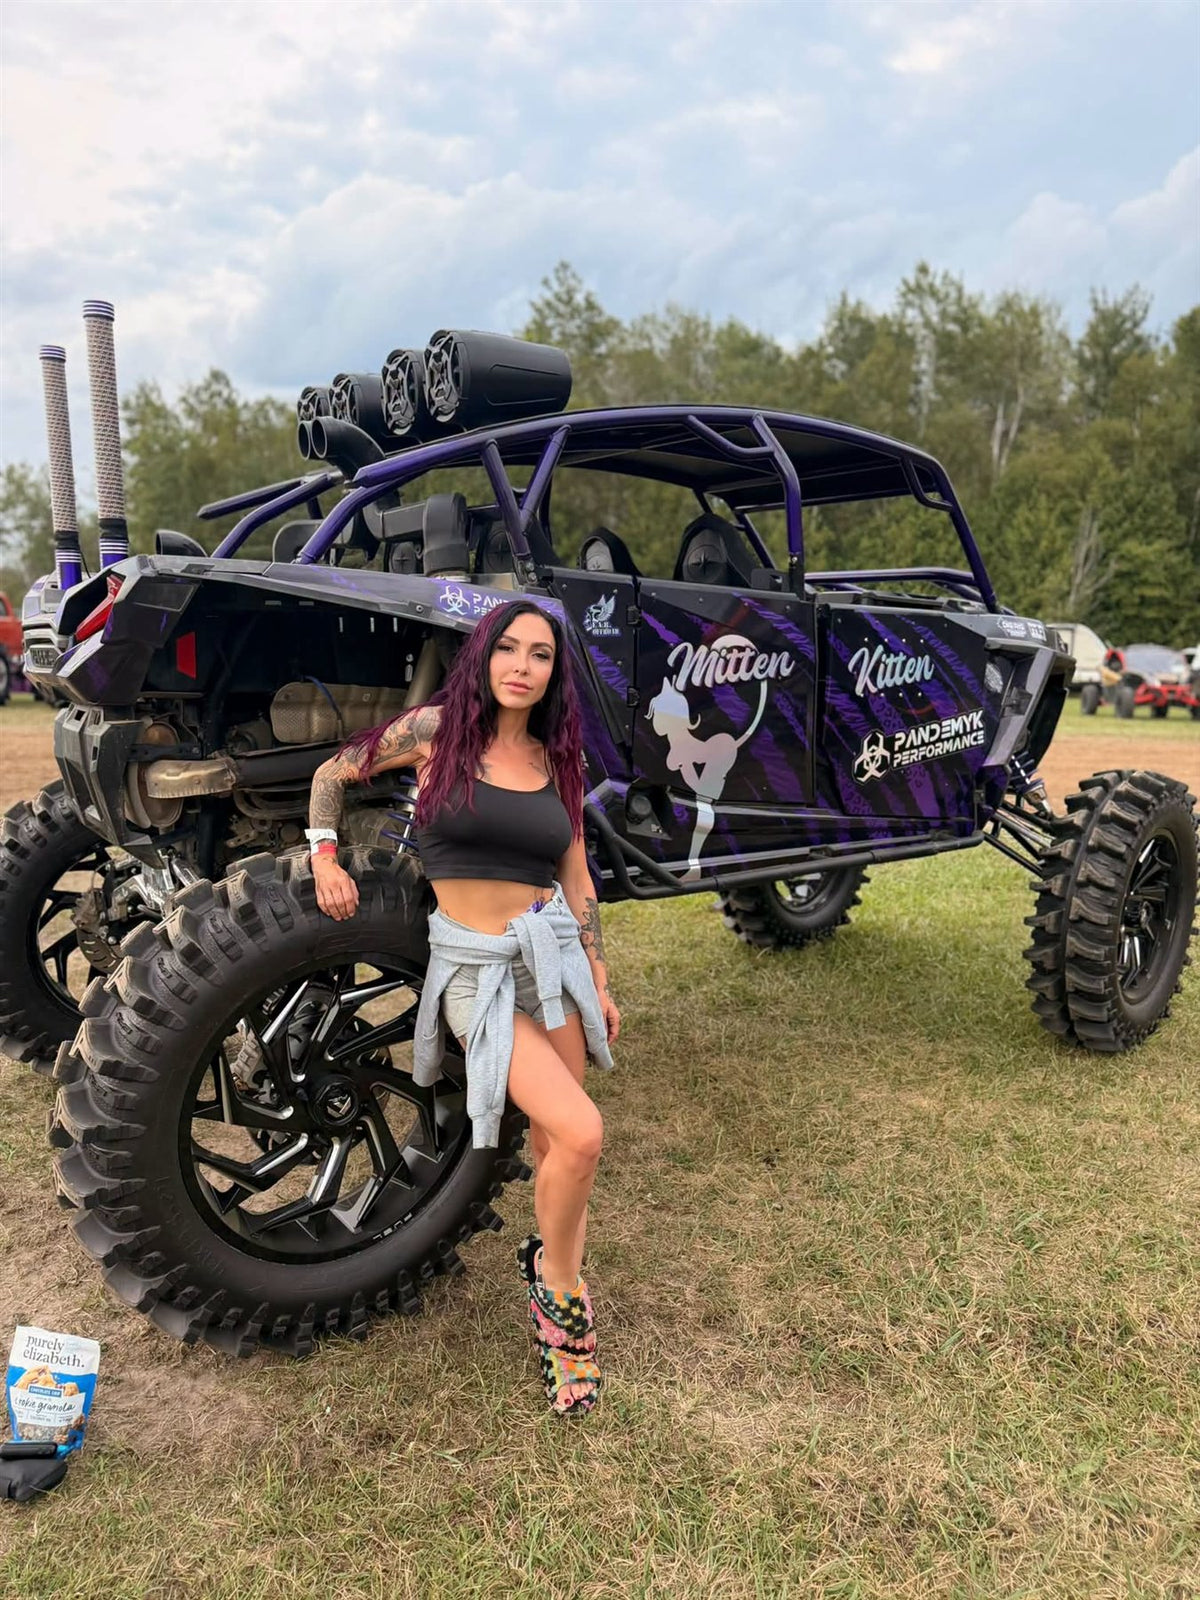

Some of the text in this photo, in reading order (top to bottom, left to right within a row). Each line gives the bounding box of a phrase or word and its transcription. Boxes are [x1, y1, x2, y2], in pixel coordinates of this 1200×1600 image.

[667, 642, 795, 692] Mitten
[848, 646, 935, 697] Kitten
[894, 709, 984, 750] PANDEMYK
[893, 730, 985, 766] PERFORMANCE
[23, 1348, 85, 1368] elizabeth.
[26, 1335, 65, 1354] purely
[36, 1402, 76, 1413] granola
